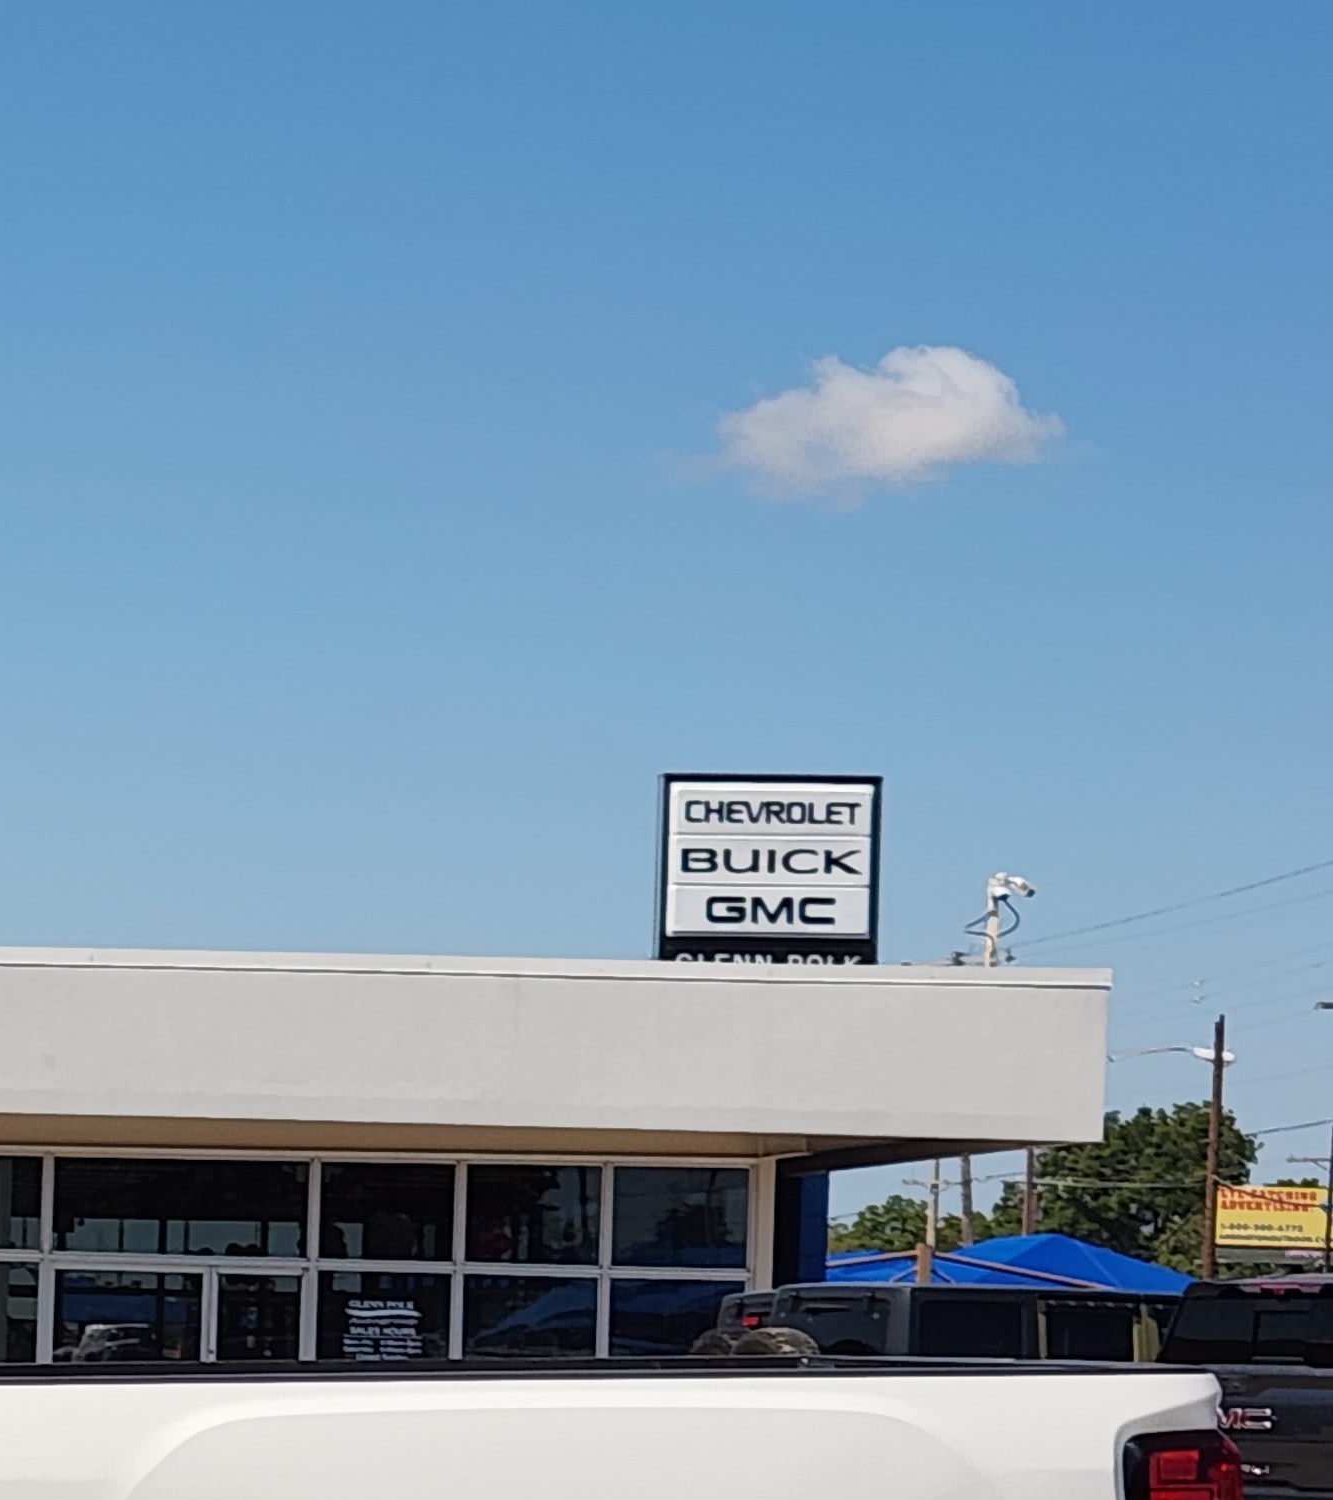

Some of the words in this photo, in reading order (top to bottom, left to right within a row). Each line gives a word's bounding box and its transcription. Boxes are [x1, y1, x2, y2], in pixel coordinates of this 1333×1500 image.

[684, 799, 863, 825] CHEVROLET
[680, 847, 863, 875] BUICK
[706, 896, 837, 925] GMC
[1216, 1407, 1273, 1429] MC
